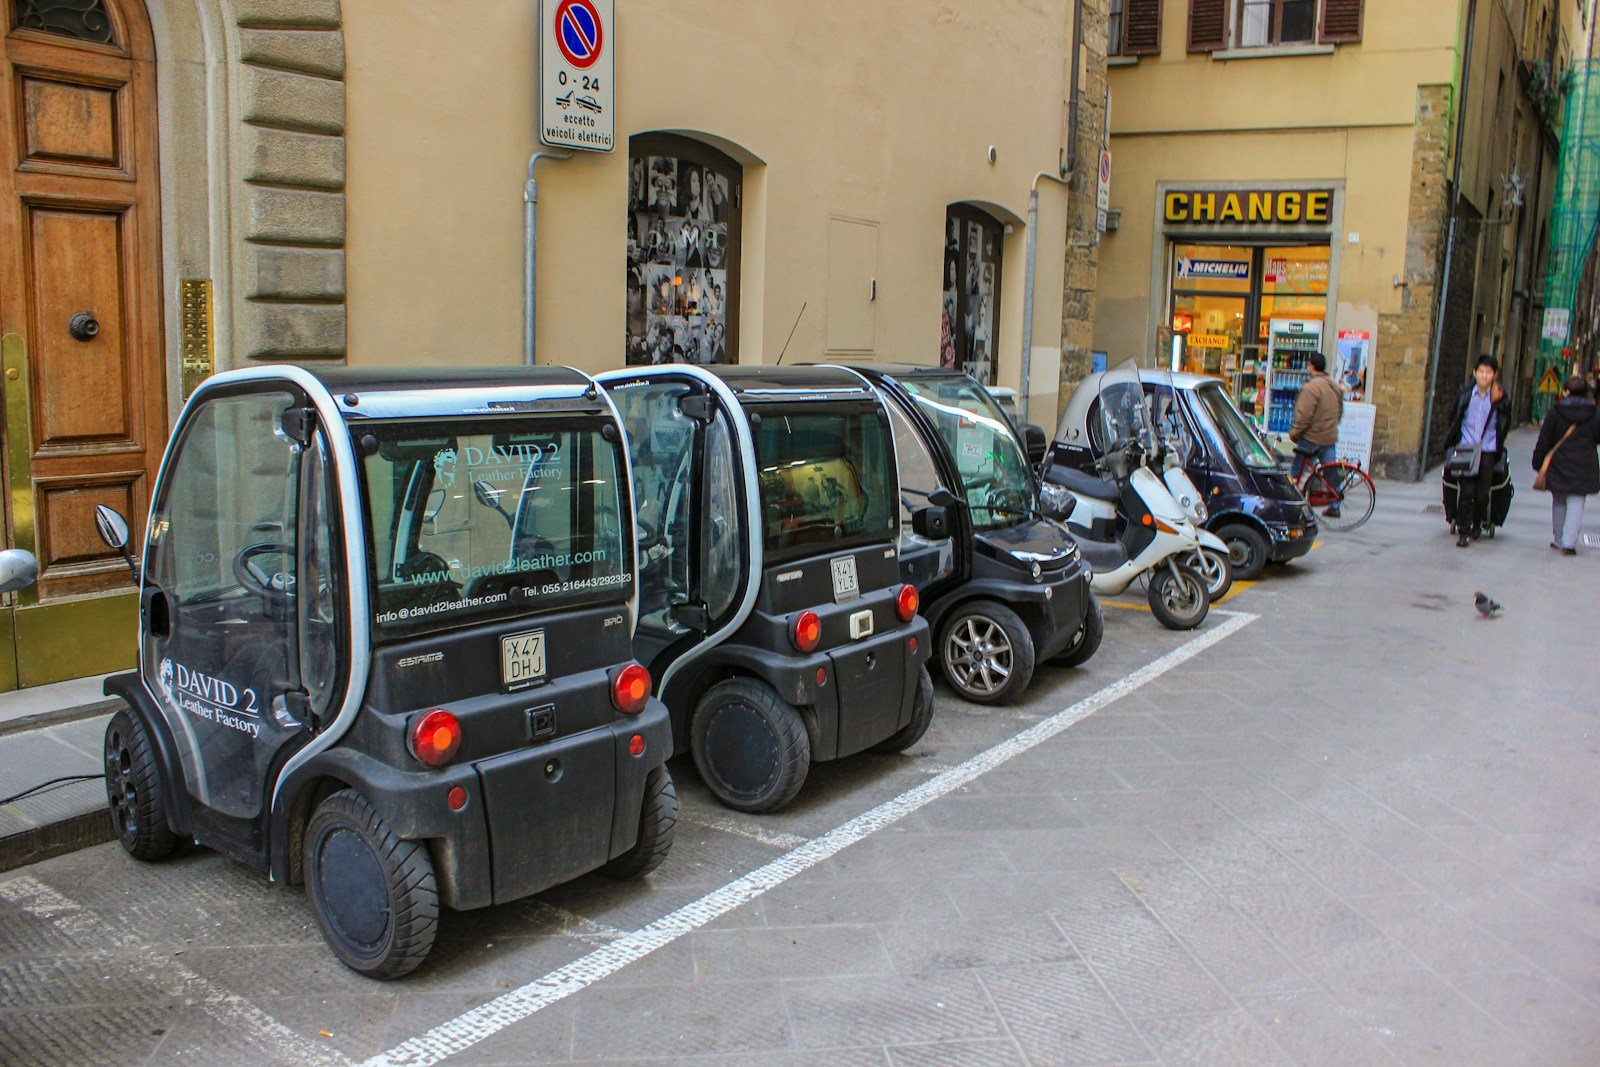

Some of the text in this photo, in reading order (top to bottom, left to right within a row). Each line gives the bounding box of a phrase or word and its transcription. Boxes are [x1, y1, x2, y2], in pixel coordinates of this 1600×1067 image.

[582, 75, 600, 92] 24
[563, 113, 595, 127] eccetto
[546, 126, 612, 146] veicoli elettrici
[1165, 191, 1329, 222] CHANGE
[1193, 262, 1248, 275] MICHELIN
[1190, 336, 1225, 345] EXCHANGE
[464, 443, 561, 466] DAVID 2
[468, 466, 563, 482] Leather Factory
[411, 548, 606, 586] www.david2leather.com
[522, 573, 632, 598] Tel. 055 216443/292323
[376, 592, 507, 624] info@david2leather.com
[511, 637, 539, 659] X47
[511, 656, 540, 679] DHJ
[176, 663, 259, 714] DAVID 2
[179, 693, 260, 738] Leather Factory
